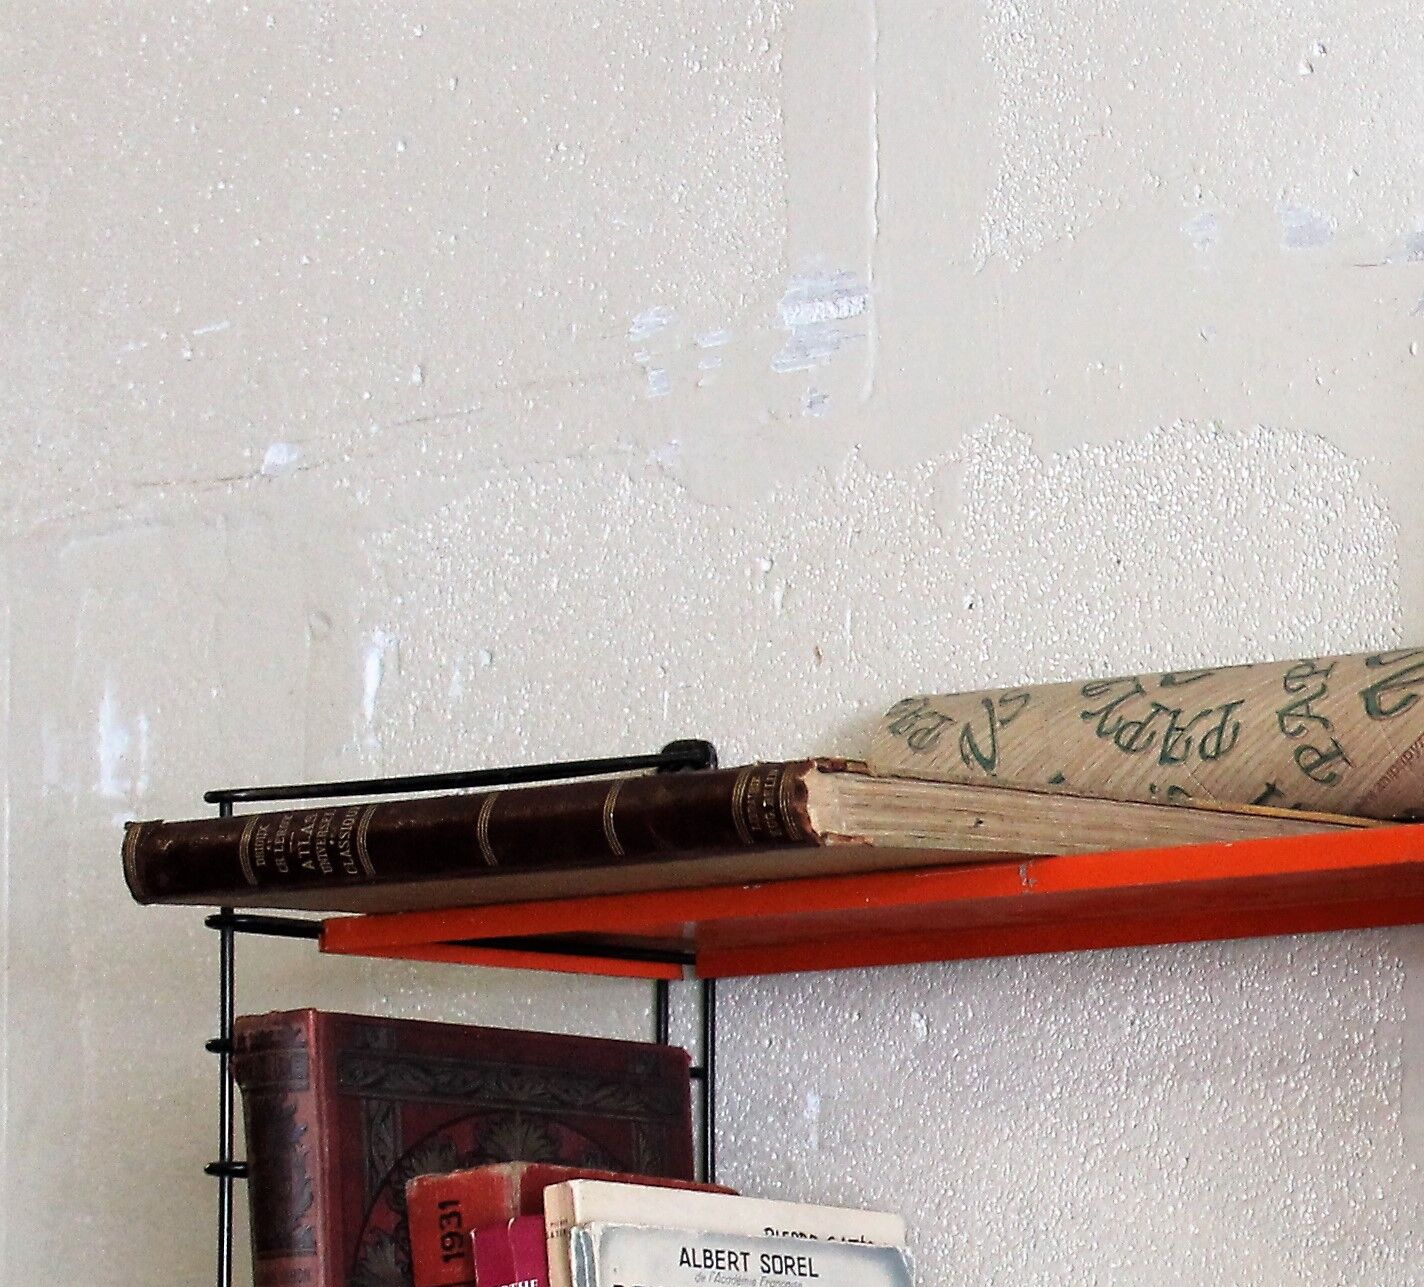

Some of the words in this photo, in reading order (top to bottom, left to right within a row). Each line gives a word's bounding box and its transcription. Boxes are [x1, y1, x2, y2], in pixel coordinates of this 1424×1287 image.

[298, 812, 318, 870] ATLAS
[438, 1200, 464, 1263] 1931
[679, 1247, 750, 1272] ALBERT
[760, 1253, 819, 1278] SOREL
